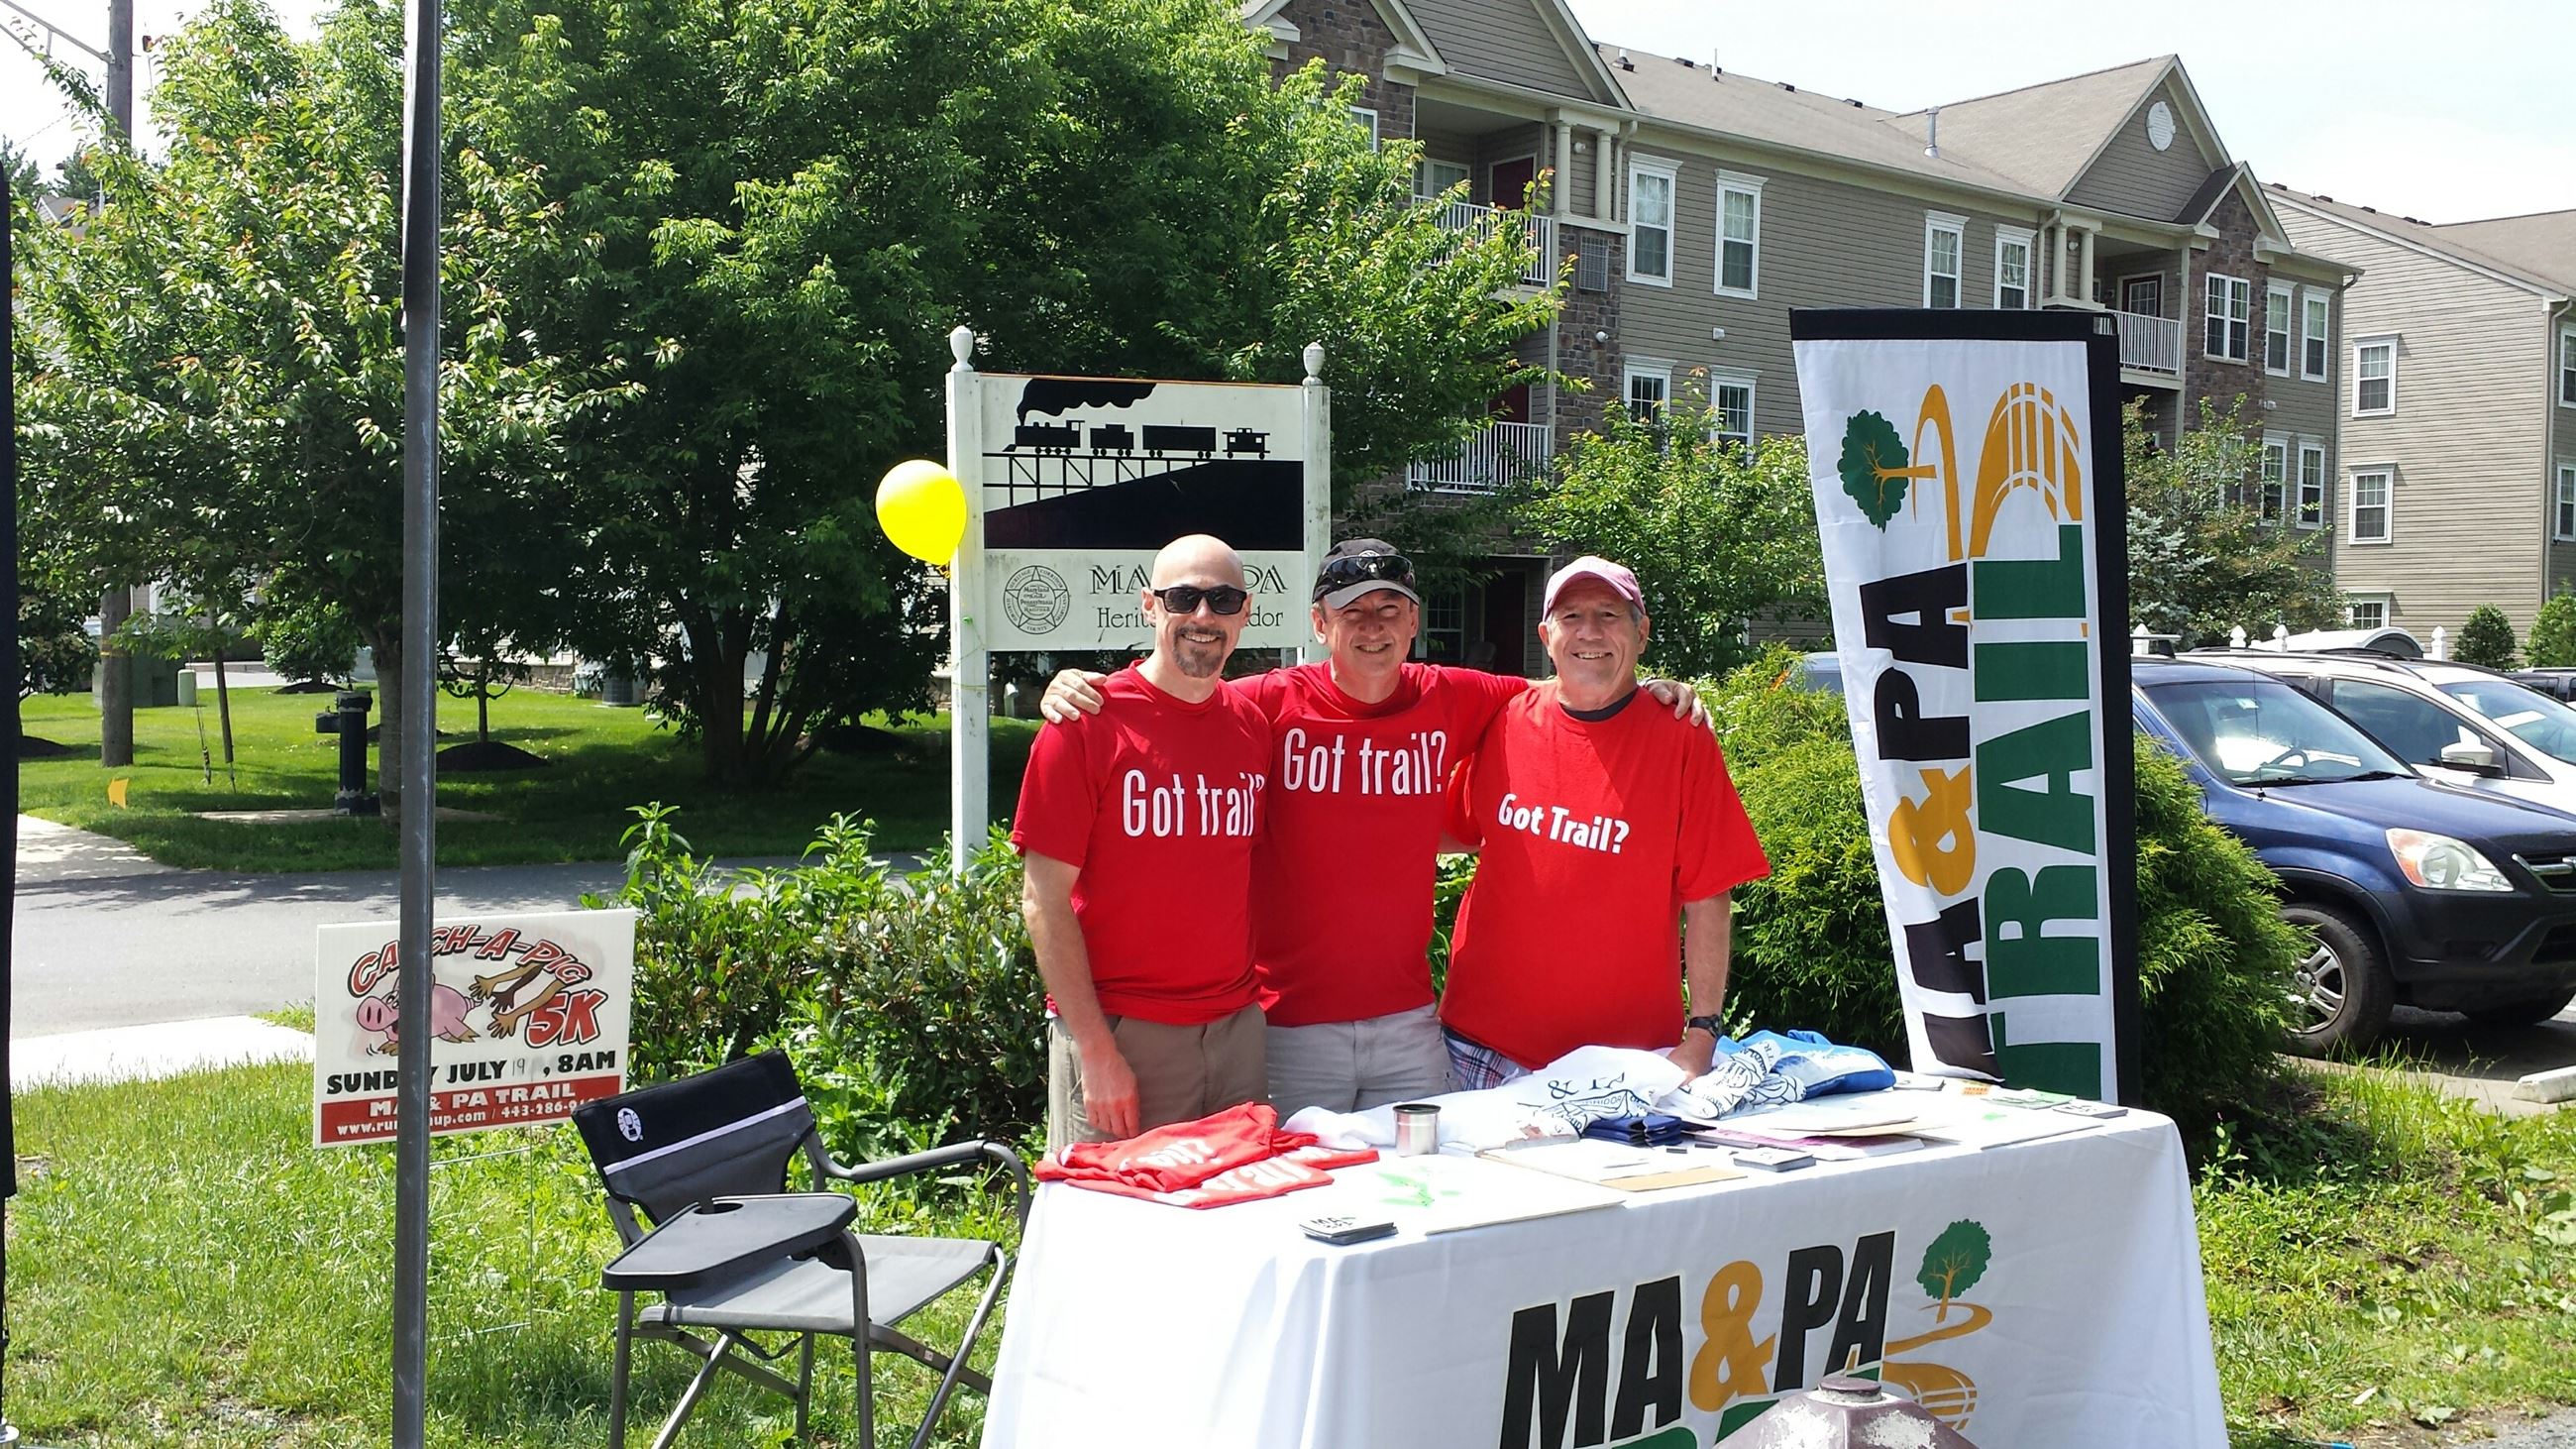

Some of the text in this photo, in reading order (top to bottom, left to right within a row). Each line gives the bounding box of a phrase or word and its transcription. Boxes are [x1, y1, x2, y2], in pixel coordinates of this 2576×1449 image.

[1089, 564, 1151, 595] MA
[1097, 606, 1156, 628] Herit
[1284, 727, 1448, 795] Got trail?
[1123, 769, 1186, 837] Got
[1497, 793, 1631, 854] Got Trail?
[1973, 524, 2102, 1102] TRAIL
[348, 925, 592, 999] CACH-A-PIG
[524, 989, 609, 1050] 5K
[326, 1065, 440, 1095] SUND
[447, 1059, 507, 1084] JULY
[557, 1050, 616, 1073] 8AM
[369, 1100, 398, 1118] M
[452, 1091, 488, 1109] PA
[494, 1082, 577, 1104] TRAIL
